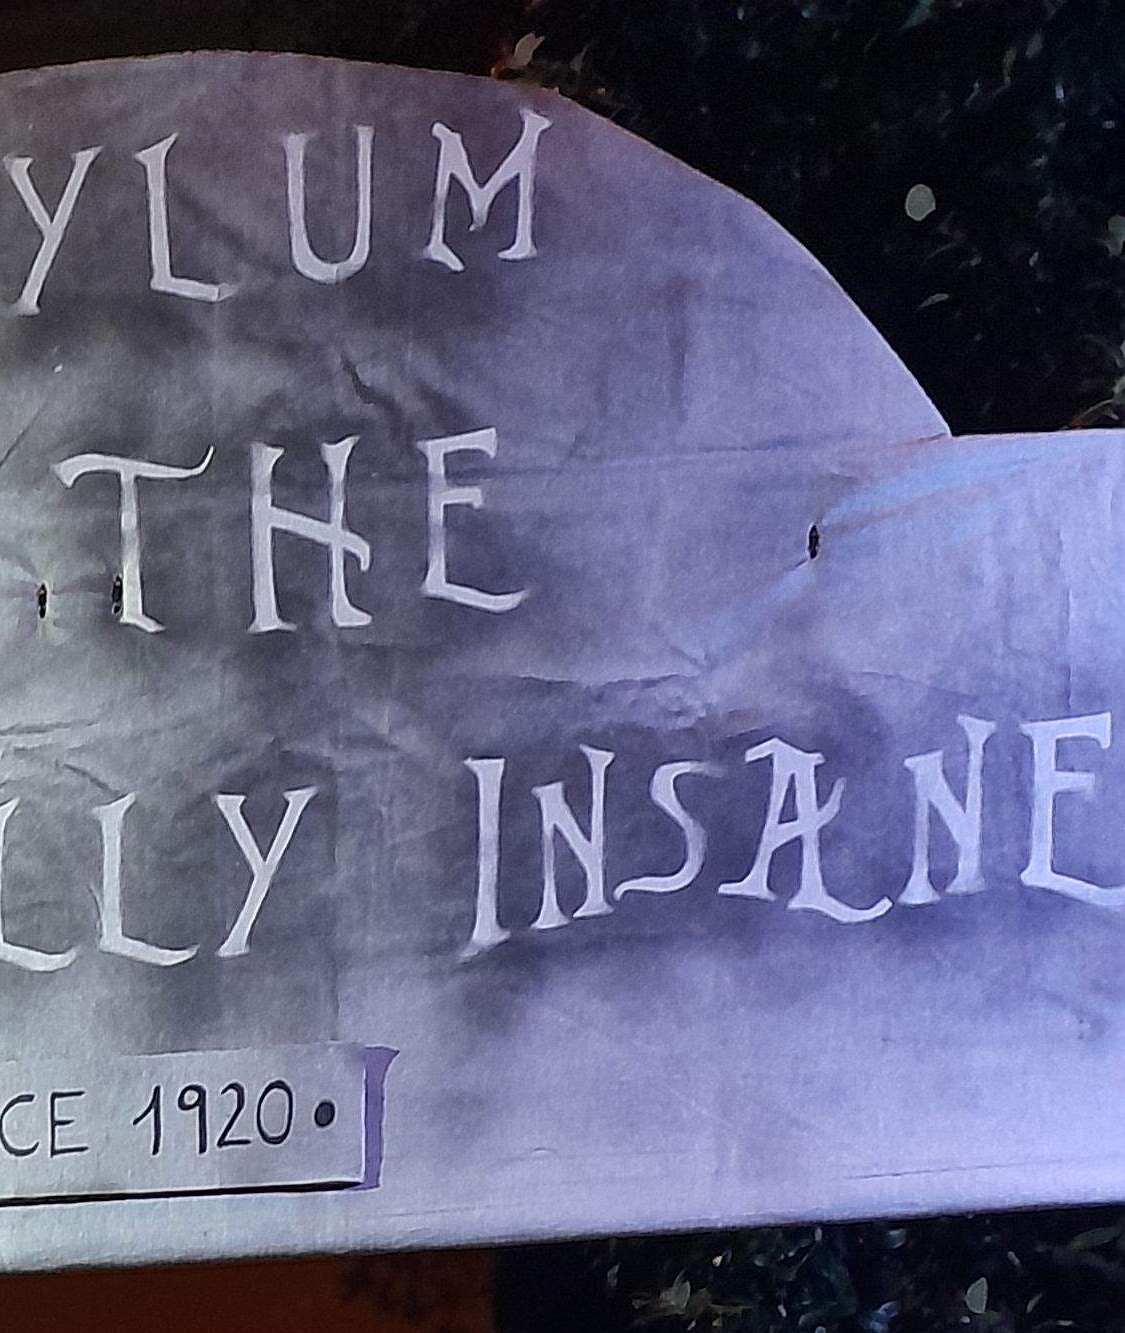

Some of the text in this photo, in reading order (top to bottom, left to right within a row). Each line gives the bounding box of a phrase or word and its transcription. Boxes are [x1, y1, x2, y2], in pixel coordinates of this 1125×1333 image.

[53, 427, 531, 636] THE
[463, 712, 1125, 963] INSANE
[132, 1079, 295, 1156] 1920
